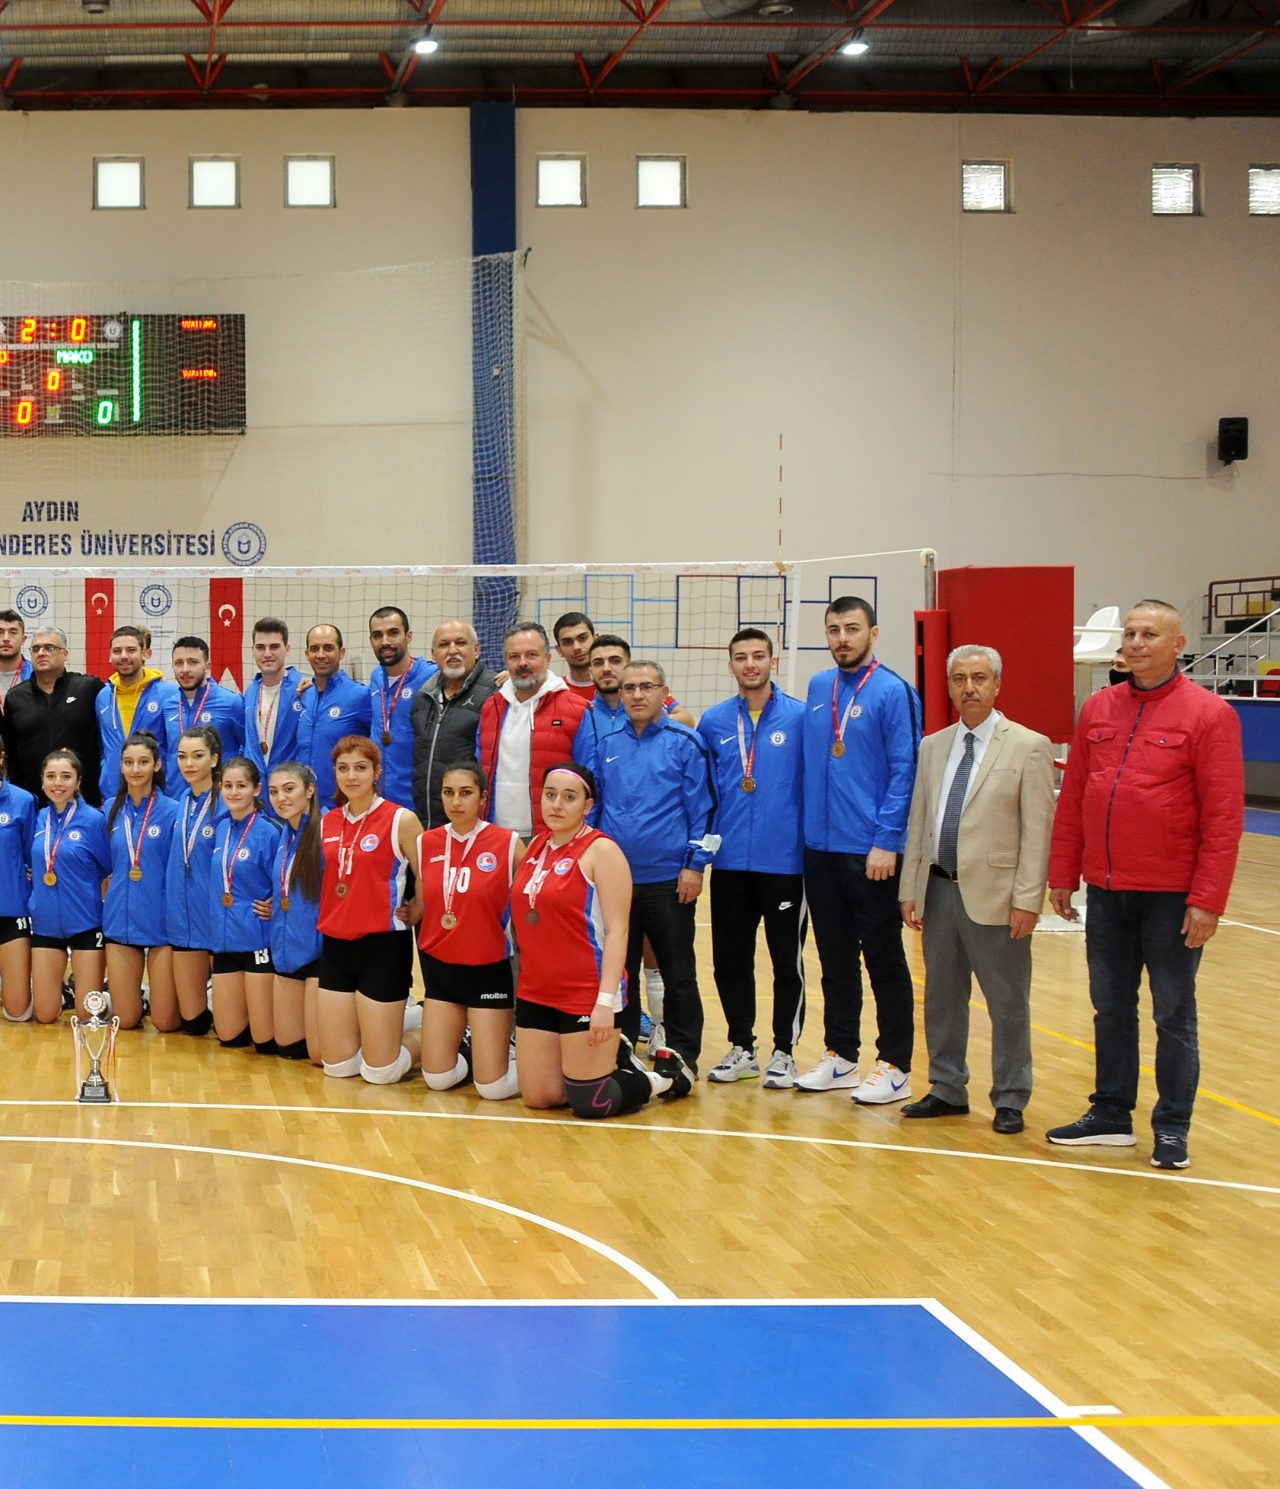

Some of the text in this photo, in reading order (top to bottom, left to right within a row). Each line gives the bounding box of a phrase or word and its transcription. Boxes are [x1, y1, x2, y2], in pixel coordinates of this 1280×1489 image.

[21, 319, 36, 342] 2
[72, 318, 86, 341] 0
[47, 370, 60, 390] 0
[17, 402, 32, 424] 0
[97, 401, 112, 424] 0
[22, 501, 79, 522] AYDIN
[80, 530, 215, 555] ÜNİVERSİTESİ
[449, 866, 471, 893] 10
[95, 932, 103, 947] 2
[254, 948, 269, 965] 13
